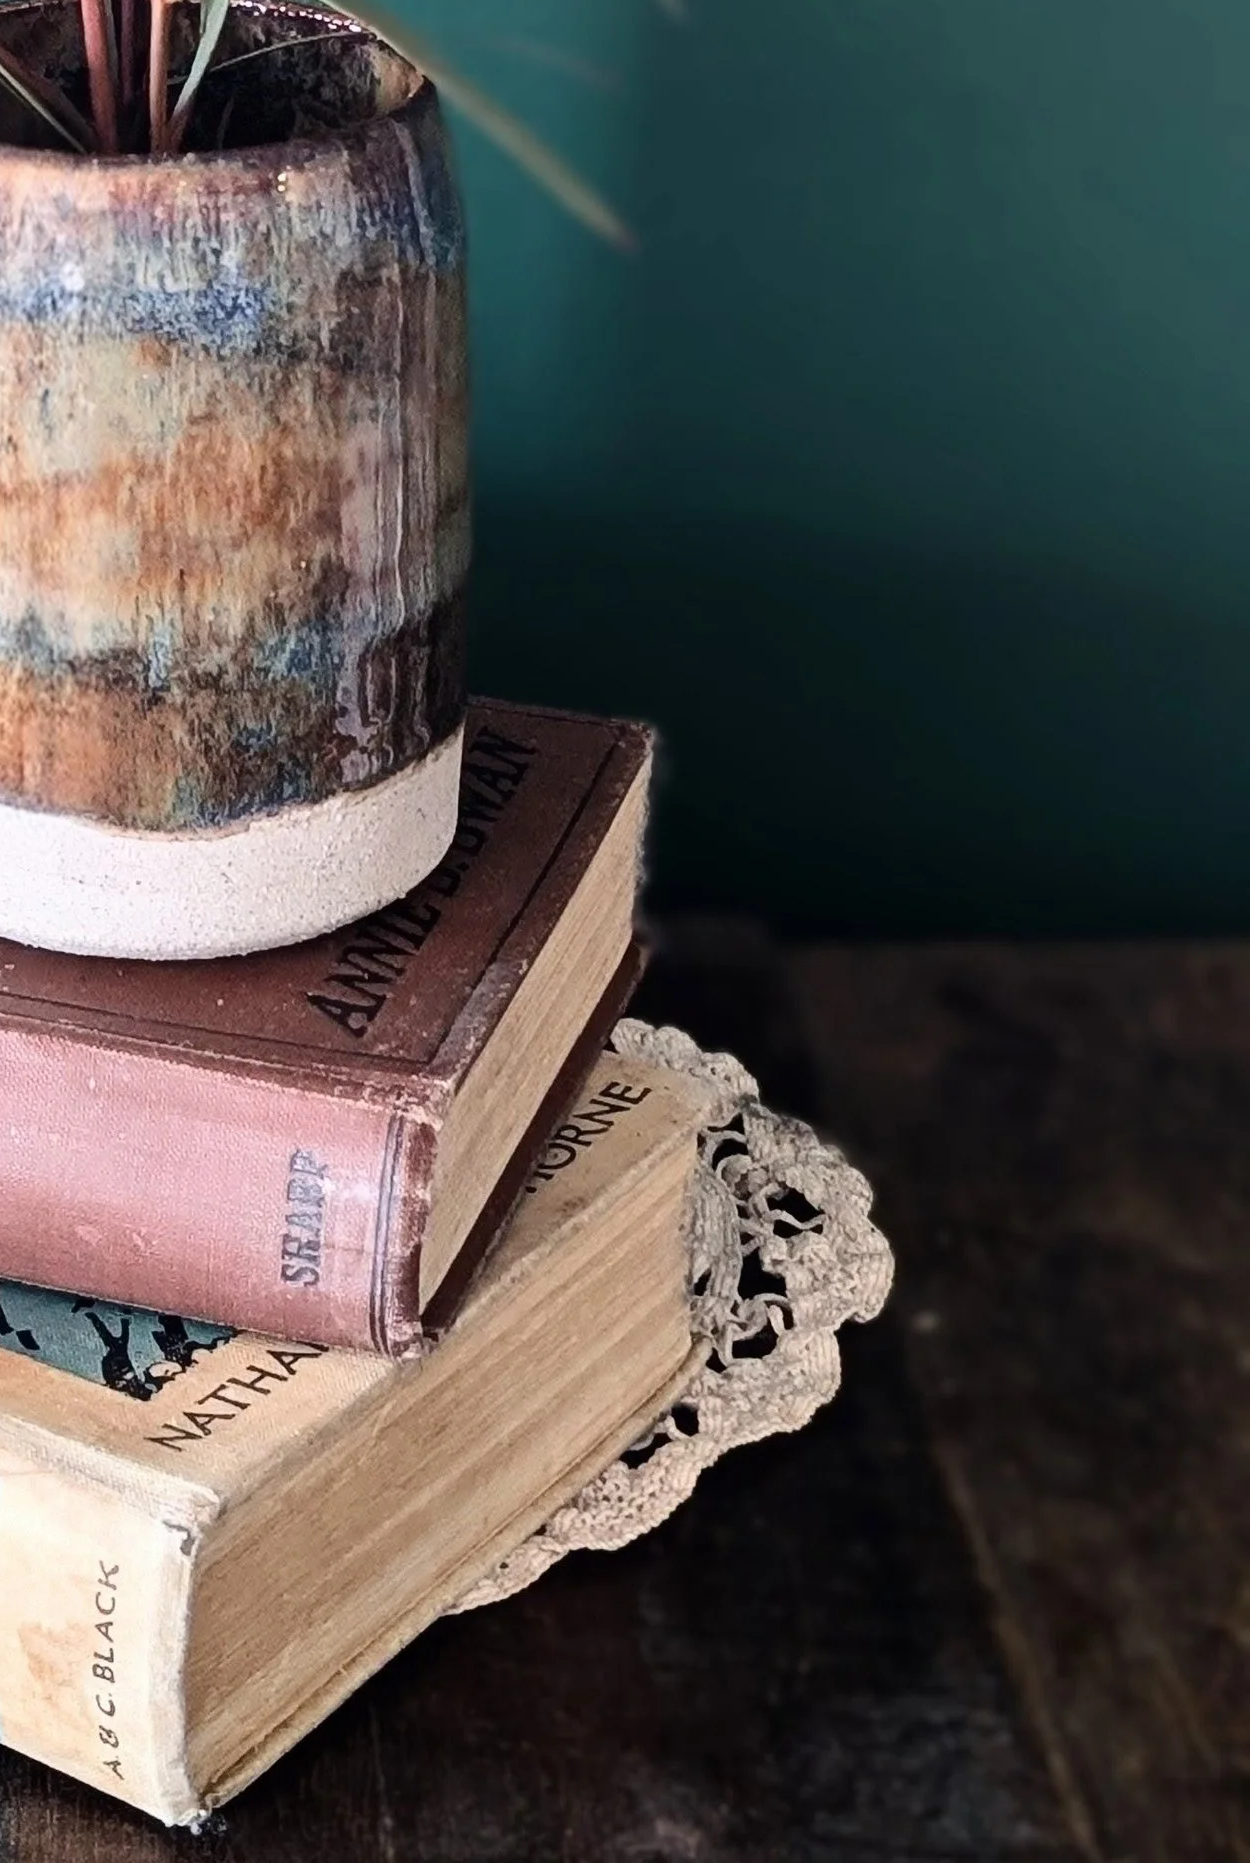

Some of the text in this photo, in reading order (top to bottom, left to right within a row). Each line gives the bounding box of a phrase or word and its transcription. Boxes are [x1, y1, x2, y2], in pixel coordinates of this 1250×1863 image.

[307, 897, 442, 1037] ANNIE
[524, 1080, 651, 1194] ORNE
[92, 1559, 120, 1684] BLACK
